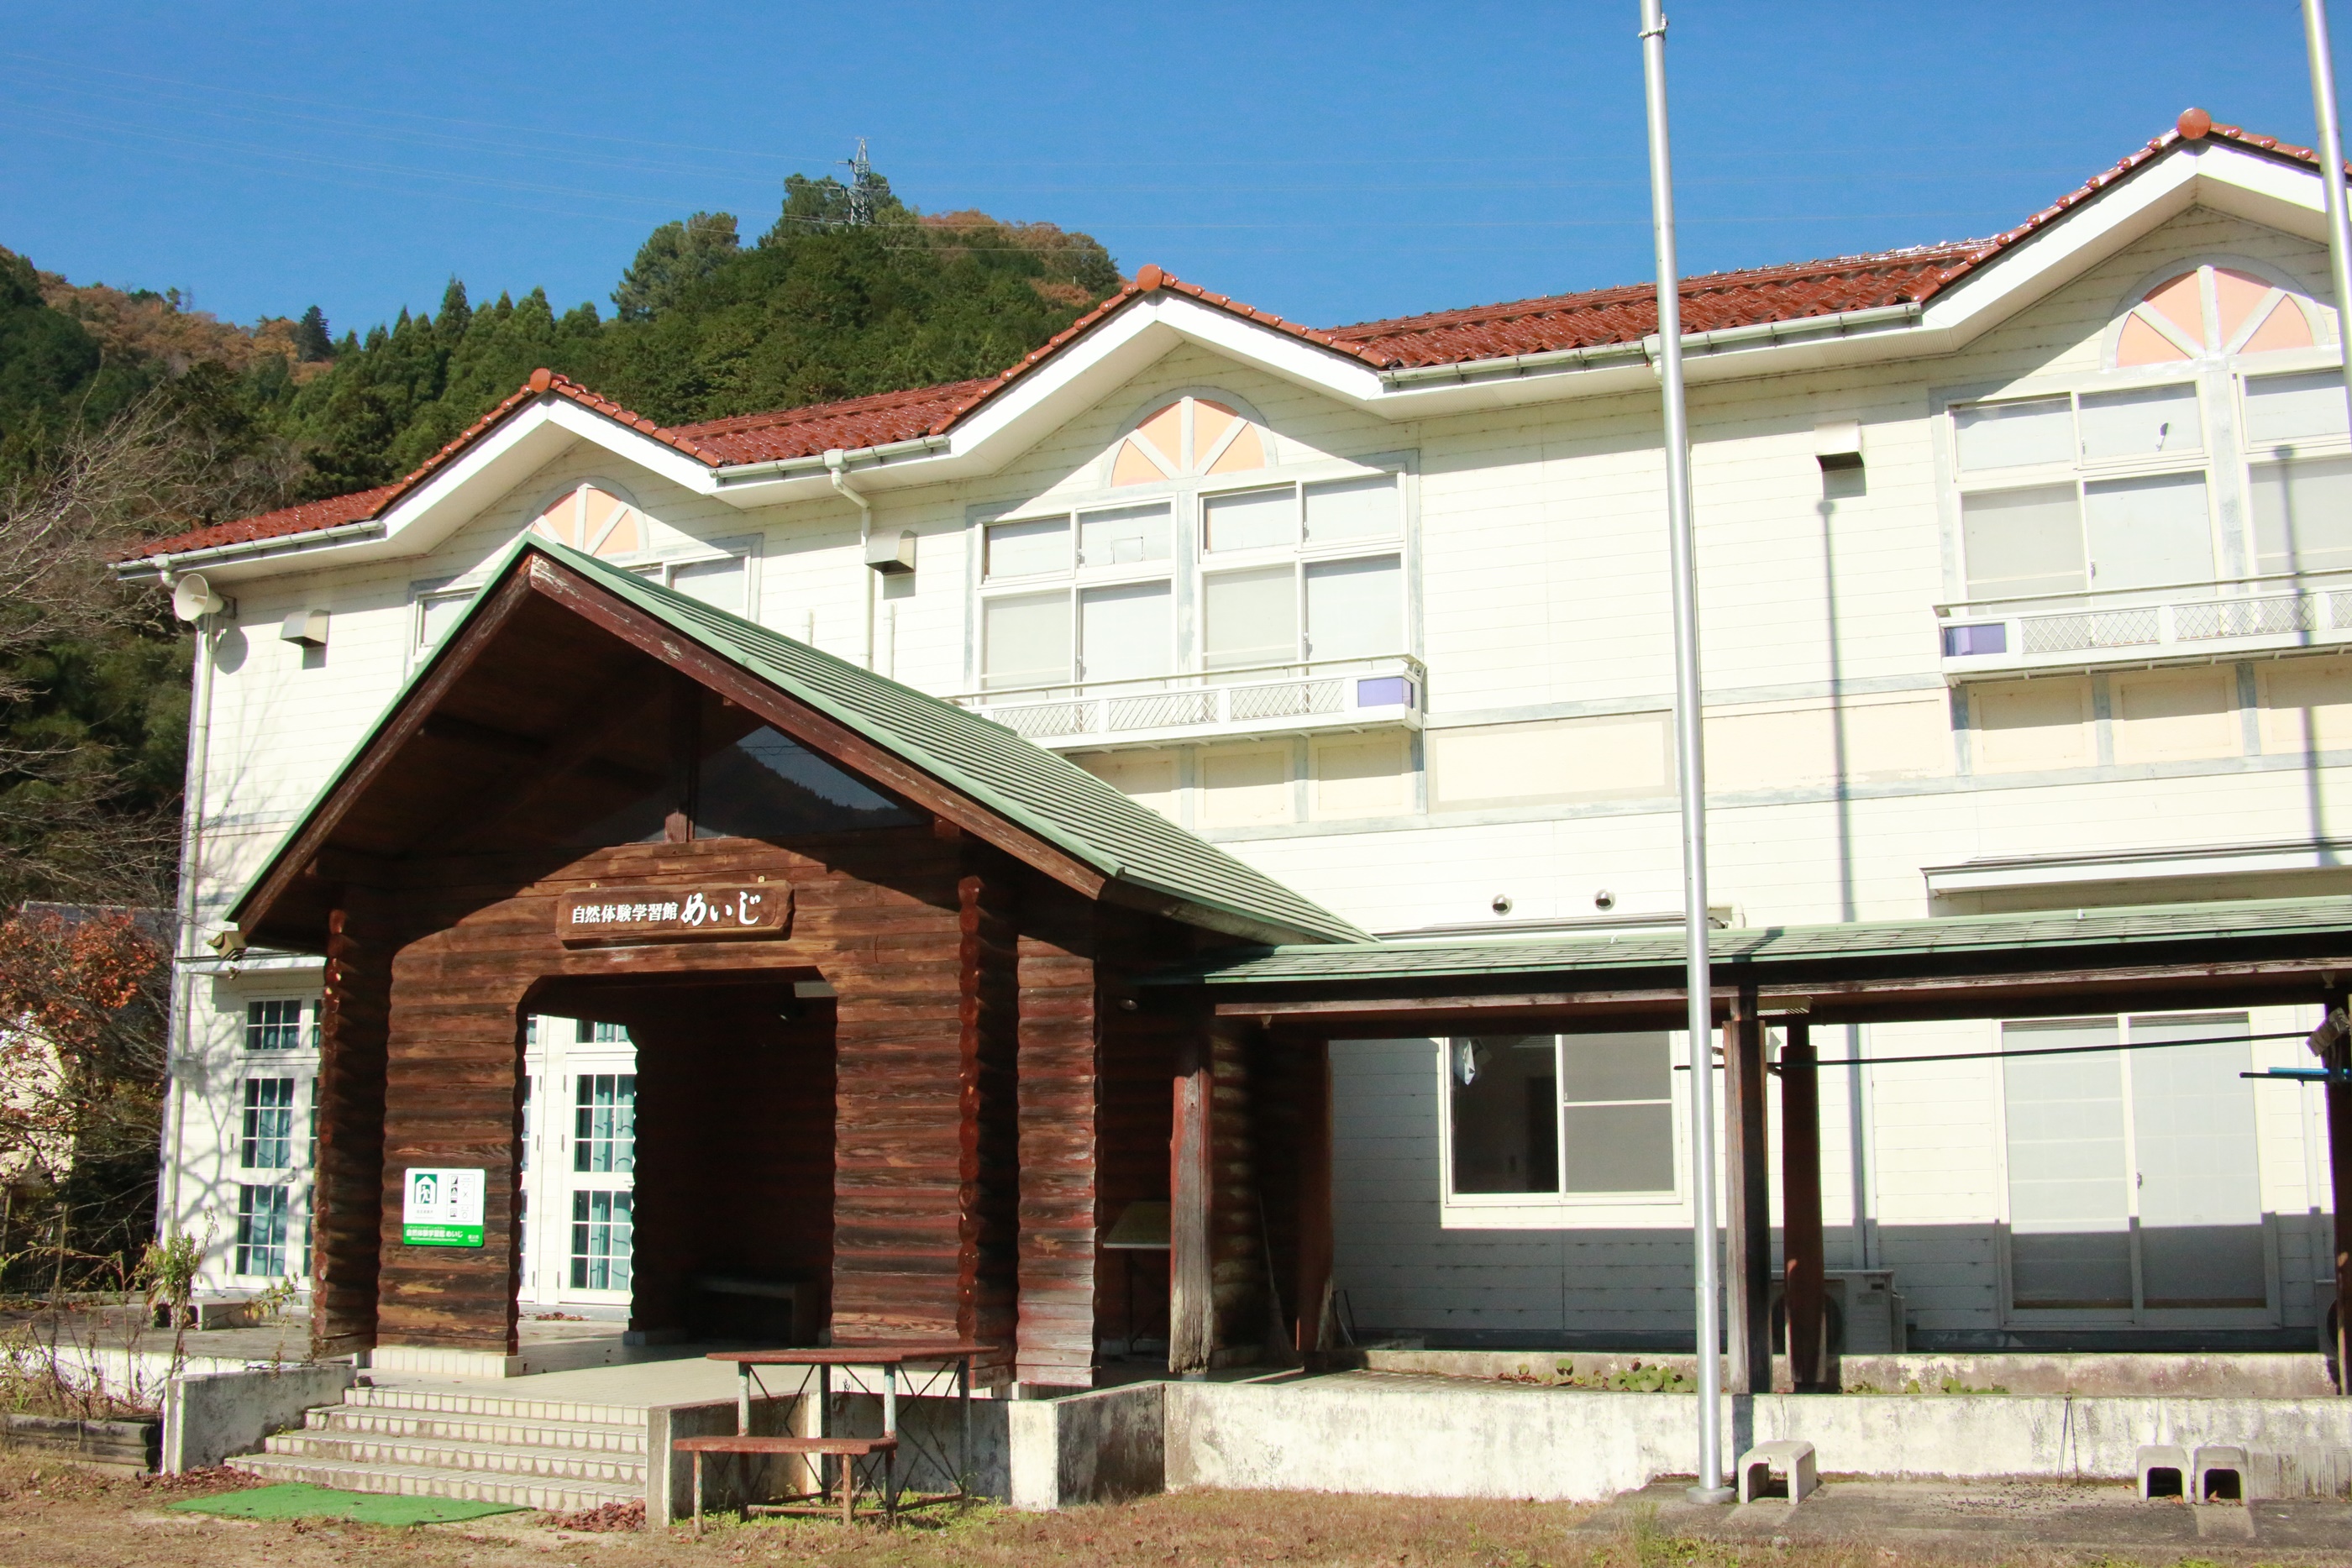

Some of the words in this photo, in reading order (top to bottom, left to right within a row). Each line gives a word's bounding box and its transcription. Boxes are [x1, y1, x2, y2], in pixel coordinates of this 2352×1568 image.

[572, 902, 679, 924] 自然体験学習館
[680, 891, 761, 926] めいじ
